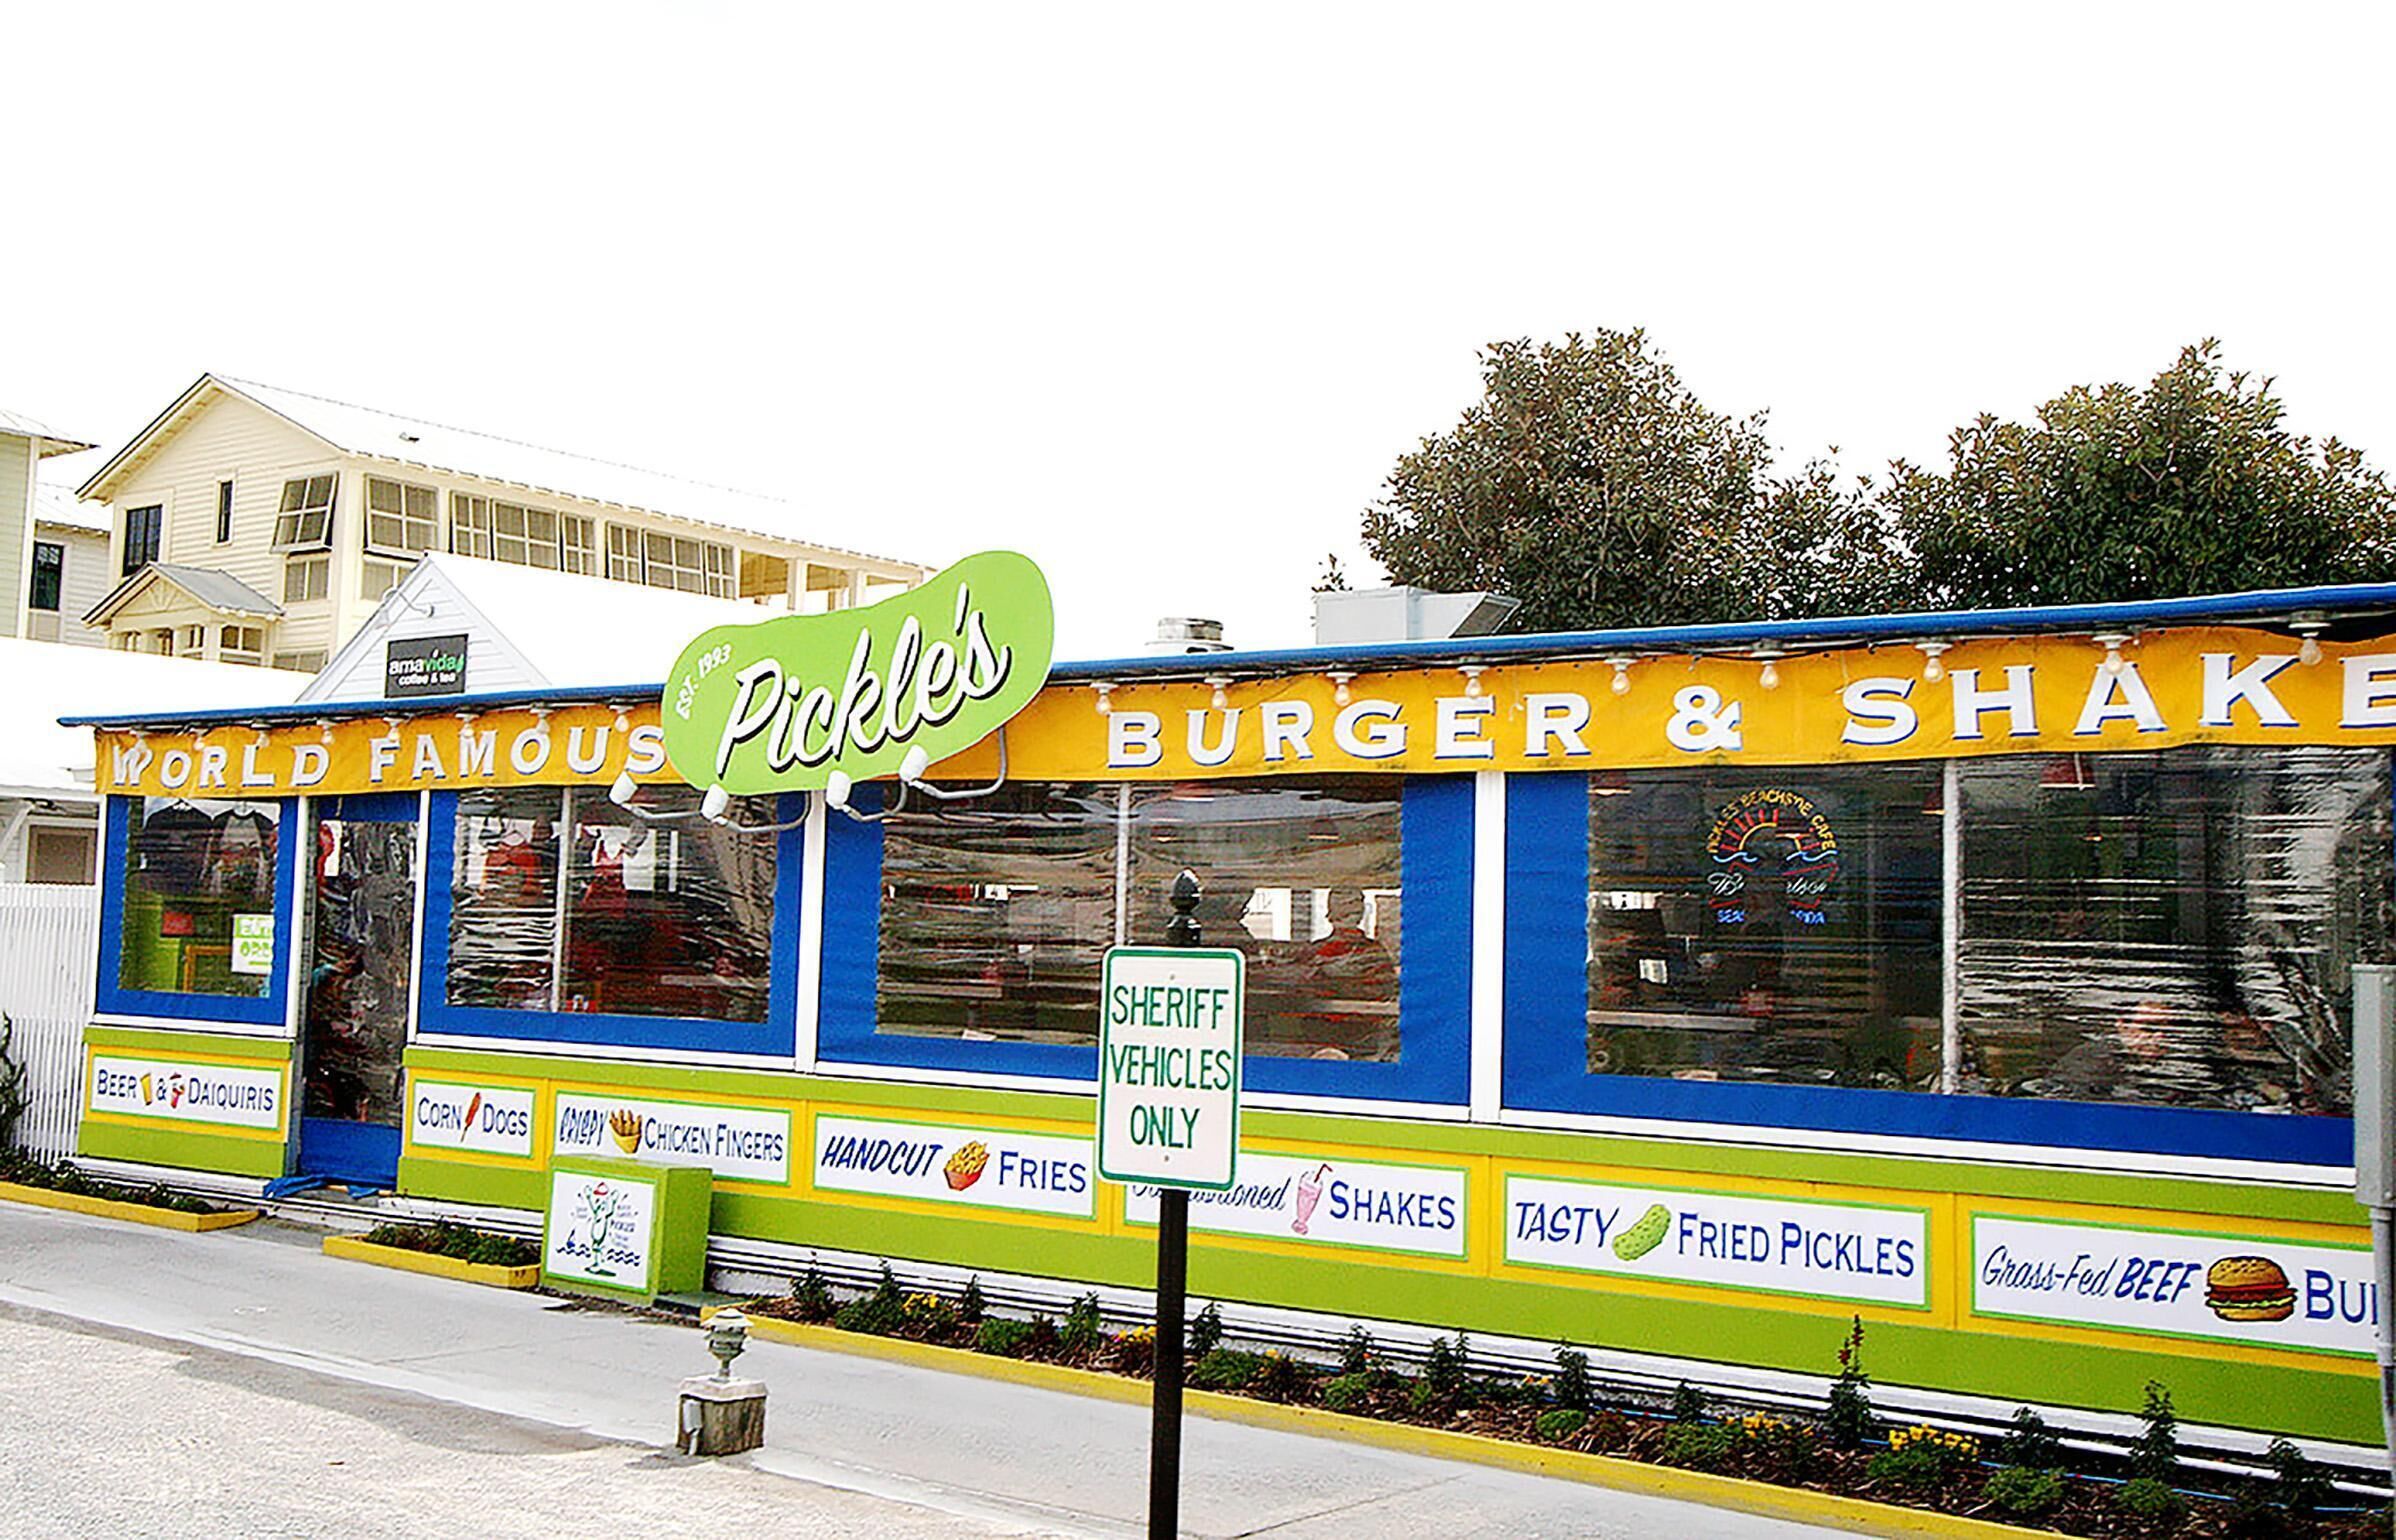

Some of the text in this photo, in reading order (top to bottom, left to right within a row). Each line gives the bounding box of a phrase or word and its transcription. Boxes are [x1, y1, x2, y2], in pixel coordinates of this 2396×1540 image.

[388, 650, 464, 674] amavida
[698, 643, 732, 679] 1993
[715, 582, 1013, 781] Pickle's
[112, 744, 331, 789] WORLD
[370, 724, 668, 783] FAMOUS
[1106, 690, 1593, 769] BURGER
[1664, 684, 1744, 753] &
[1110, 984, 1230, 1030] SHERIFF
[97, 1068, 275, 1112] BEER & DAIQUIRIS
[1109, 1043, 1232, 1092] VEHICLES
[417, 1096, 529, 1137] CORN DOGS
[644, 1117, 712, 1156] CHICKEN
[714, 1123, 784, 1162] FINGERS
[1130, 1104, 1201, 1150] ONLY
[820, 1135, 1087, 1194] HANDCUT FRIES
[1329, 1180, 1457, 1231] SHAKES
[1515, 1201, 1915, 1278] TASTY FRIED PICKLES
[1982, 1244, 2119, 1298] Grass-Fed
[2114, 1255, 2202, 1304] BEEF
